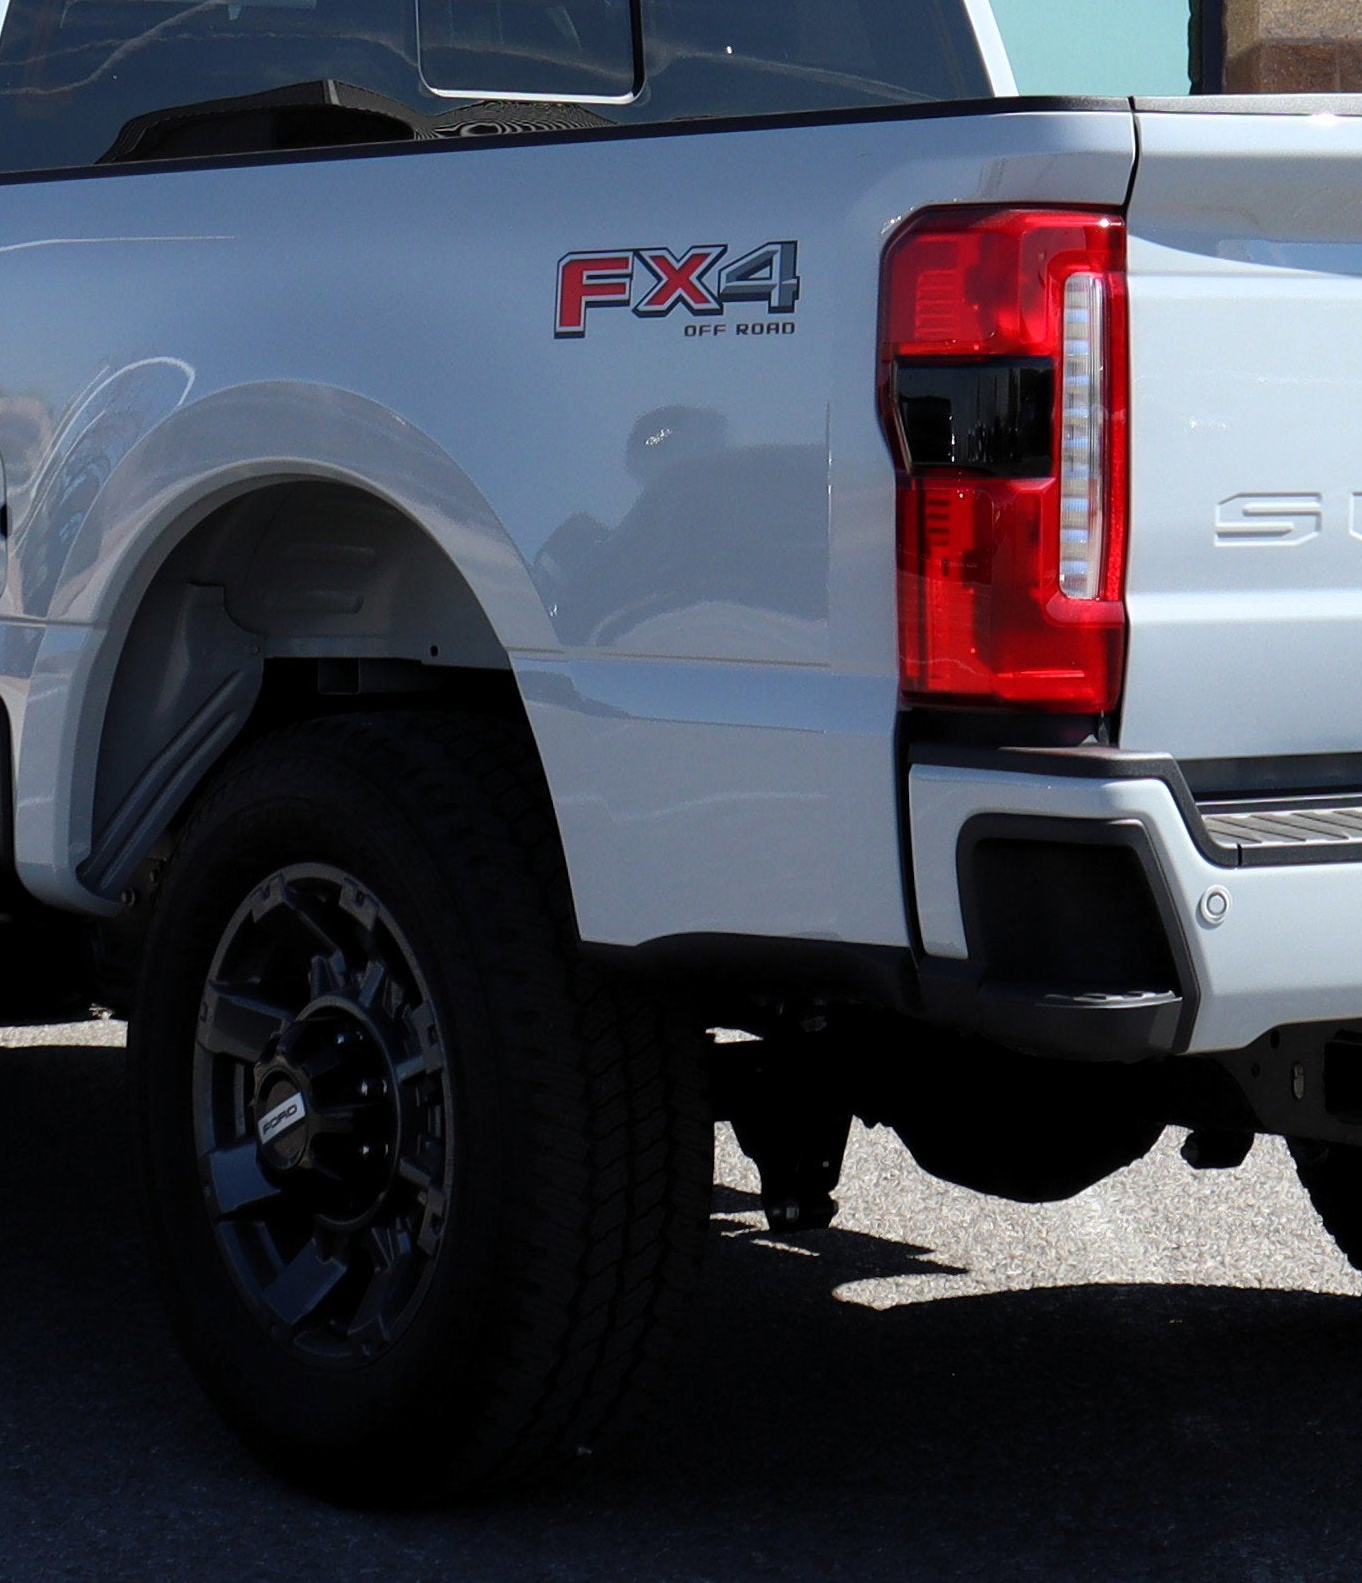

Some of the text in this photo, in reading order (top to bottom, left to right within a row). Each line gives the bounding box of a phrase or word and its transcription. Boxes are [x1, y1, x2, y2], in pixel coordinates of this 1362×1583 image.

[553, 239, 800, 339] FX4
[684, 321, 795, 337] OFF ROAD
[262, 1104, 298, 1135] FORD
